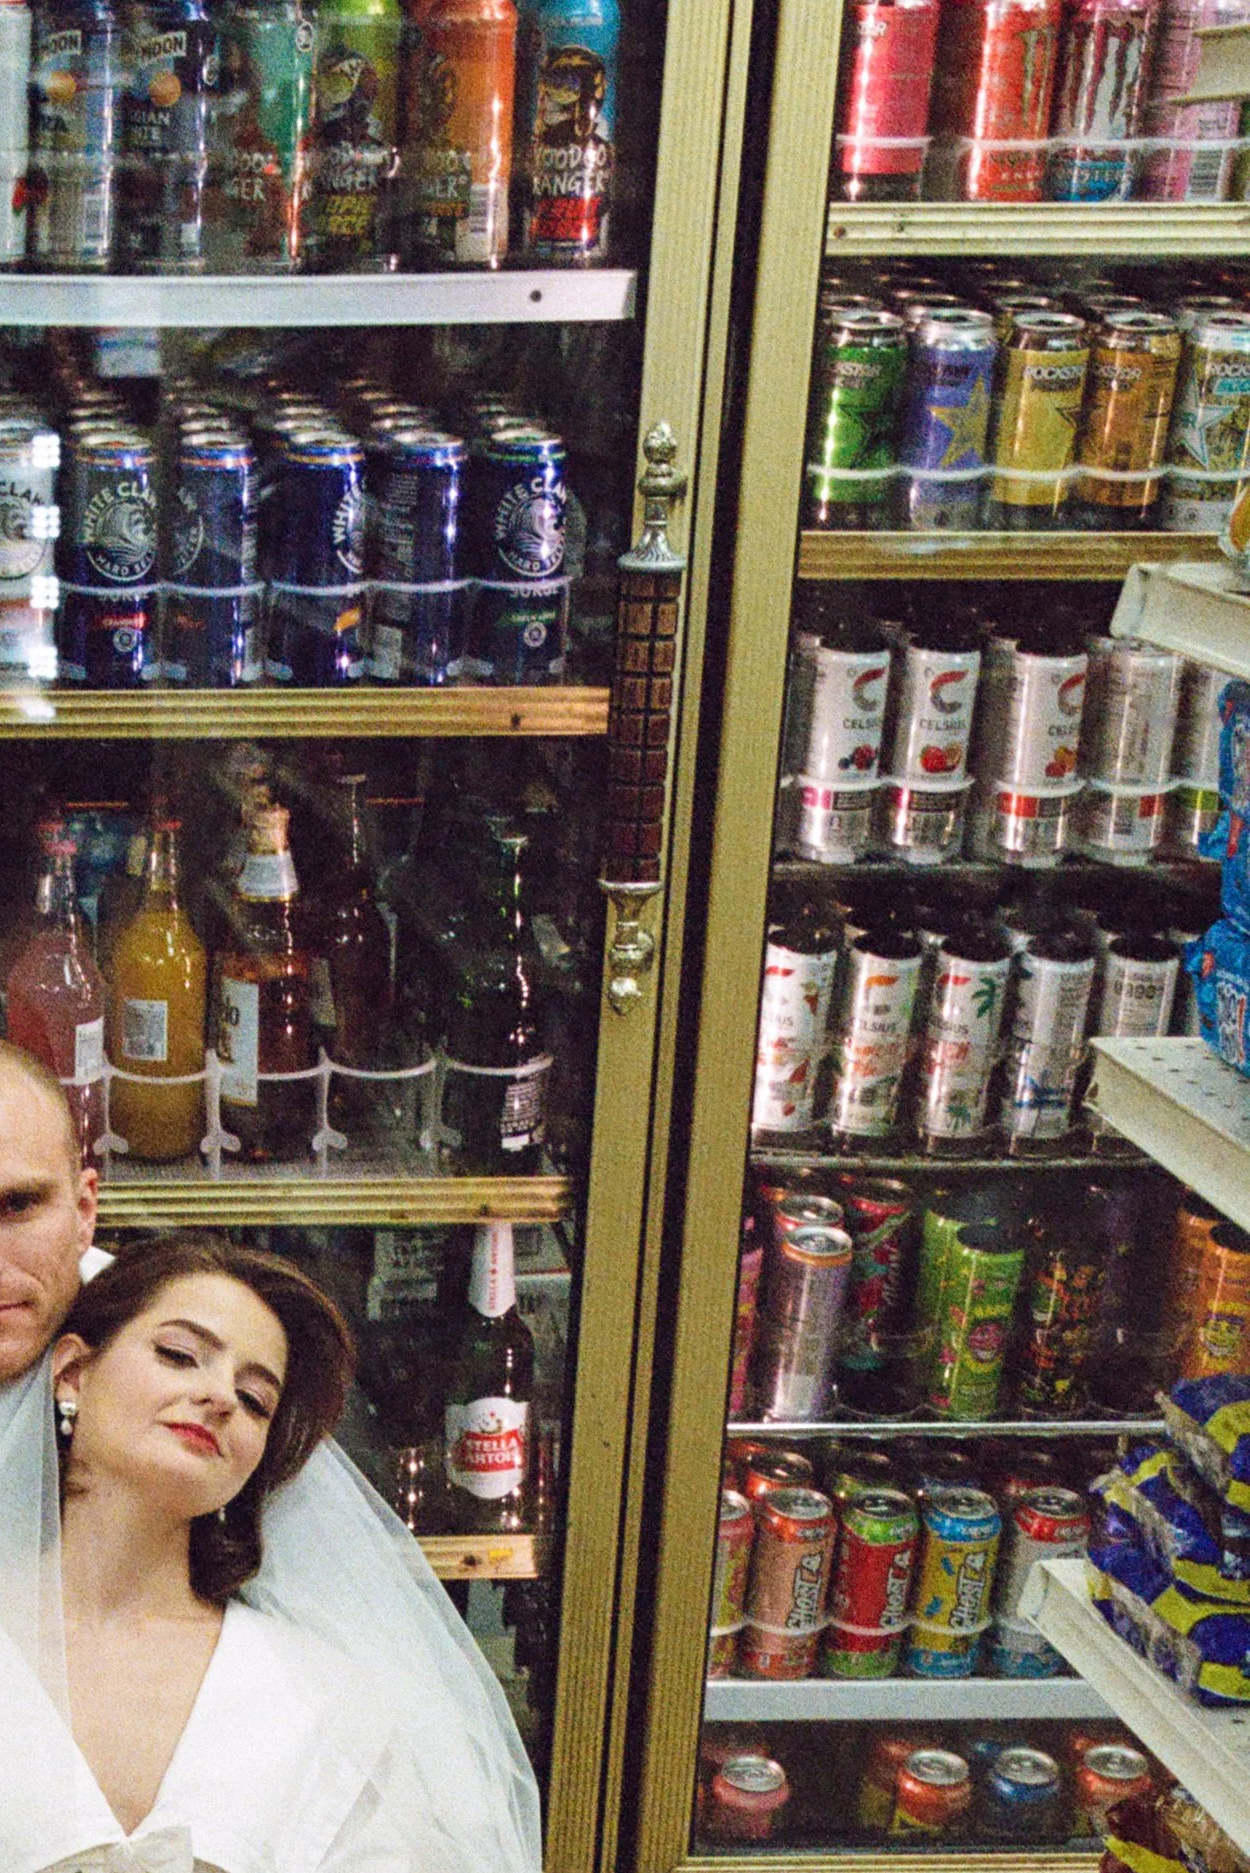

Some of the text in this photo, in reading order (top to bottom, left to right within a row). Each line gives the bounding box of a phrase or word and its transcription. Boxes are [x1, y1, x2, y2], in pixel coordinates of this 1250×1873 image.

[84, 487, 116, 543] WHITE
[495, 482, 529, 540] WHITE
[464, 1451, 520, 1465] ARTOIS
[466, 1437, 518, 1452] STELLA
[786, 1567, 823, 1629] GHOST
[878, 1566, 911, 1629] GHOST
[948, 1566, 986, 1628] GHOST
